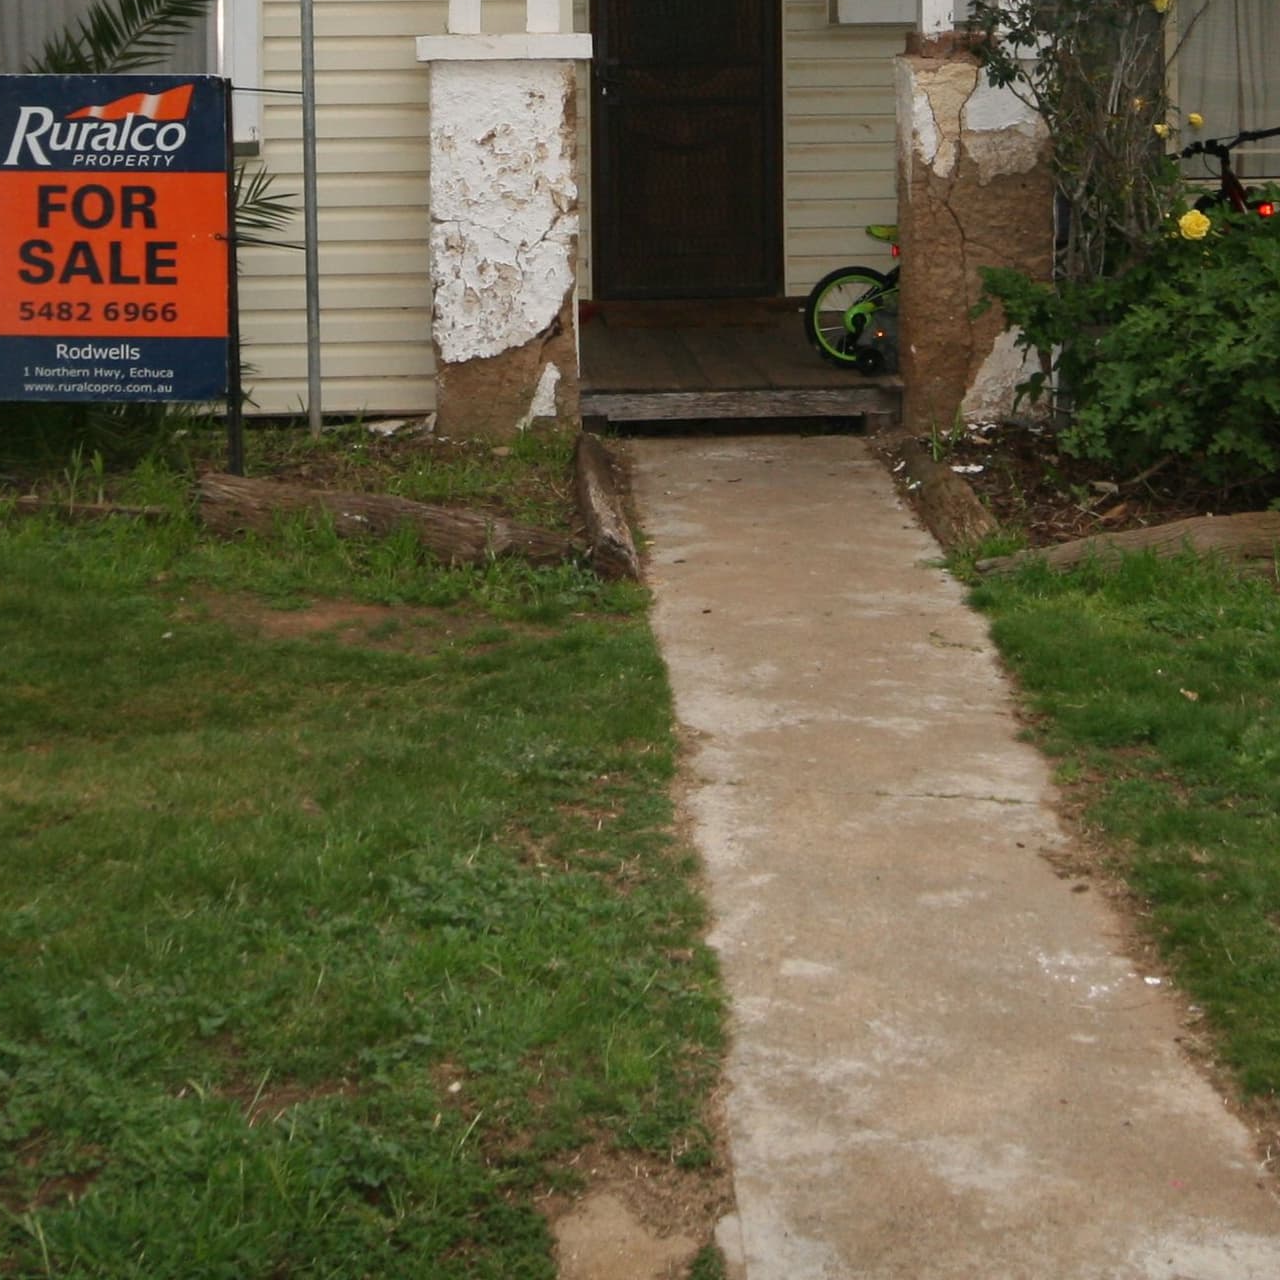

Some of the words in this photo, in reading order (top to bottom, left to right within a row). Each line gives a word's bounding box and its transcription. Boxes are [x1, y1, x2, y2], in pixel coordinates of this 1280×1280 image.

[3, 106, 186, 166] Ruralco
[72, 154, 175, 167] PROPERTY
[37, 184, 157, 229] FOR
[18, 239, 177, 286] SALE
[19, 302, 92, 321] 5482
[104, 302, 177, 322] 6966
[56, 344, 140, 360] Rodwells
[23, 367, 29, 377] 1
[35, 367, 89, 378] Northern
[94, 367, 125, 379] Hwy,
[130, 367, 174, 378] Echuca
[24, 382, 173, 394] www.ruralcopro.com.au
